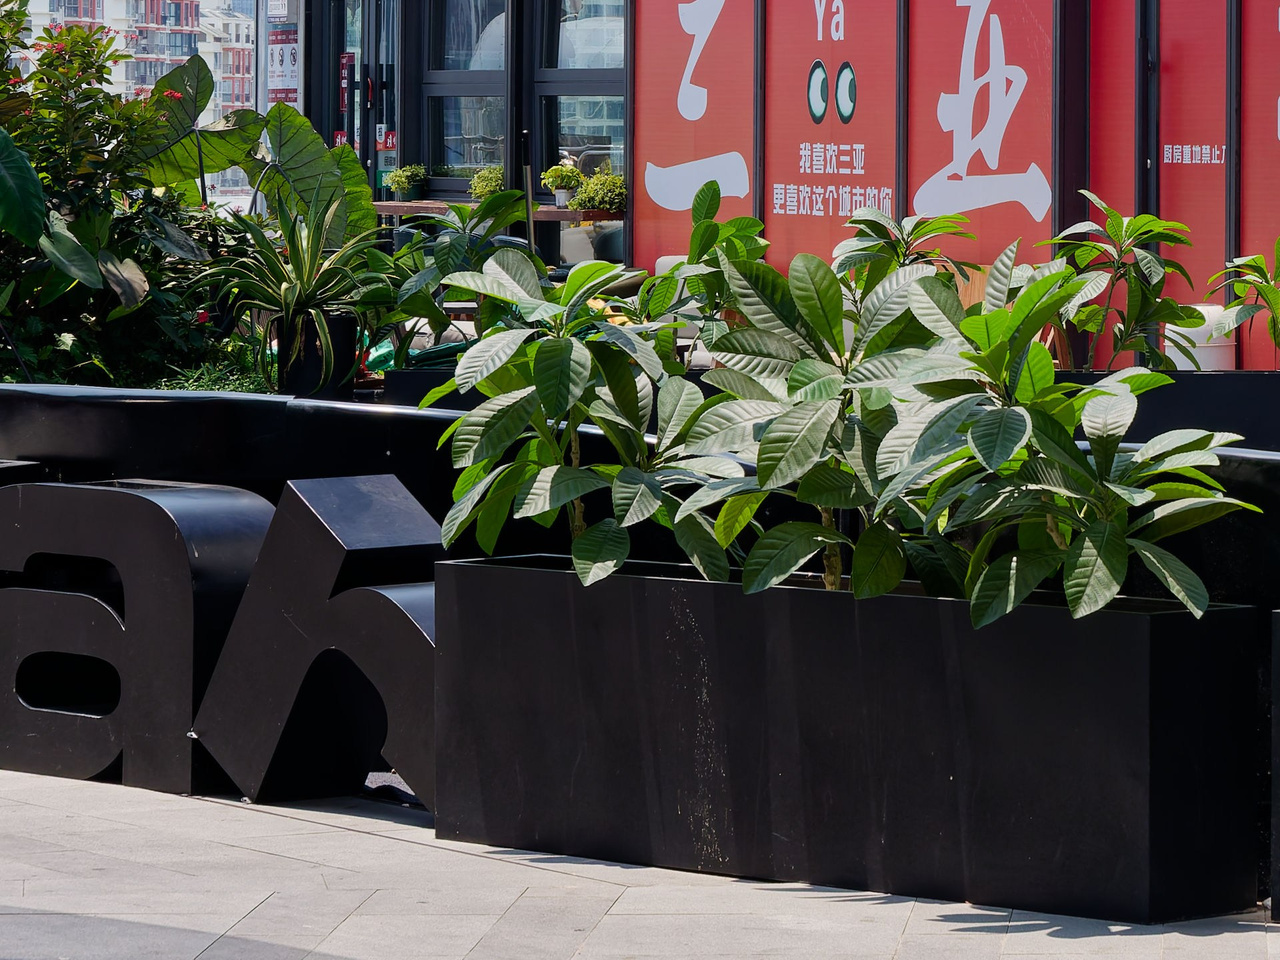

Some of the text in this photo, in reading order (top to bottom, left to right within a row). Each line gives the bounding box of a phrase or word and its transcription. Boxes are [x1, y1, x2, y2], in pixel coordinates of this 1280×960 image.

[799, 142, 865, 175] 我喜欢三亚
[773, 183, 893, 218] 更喜欢这个城市的你
